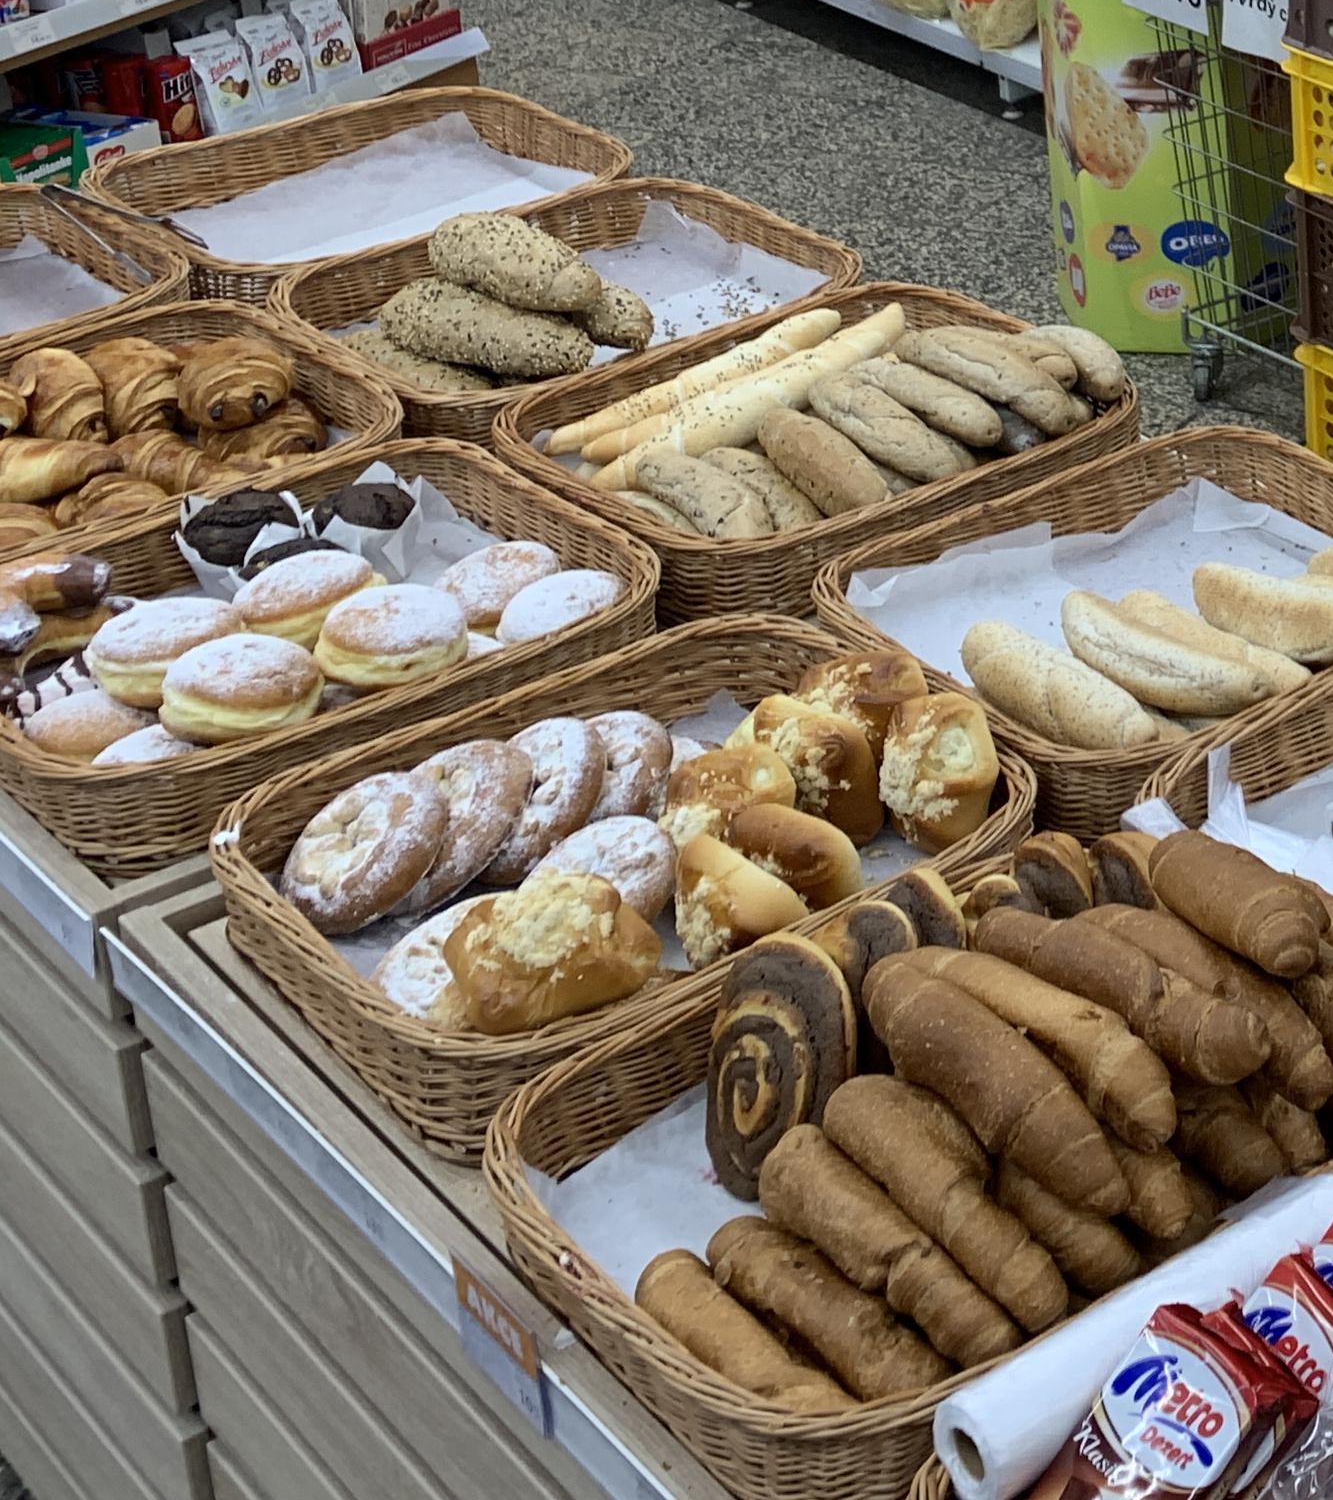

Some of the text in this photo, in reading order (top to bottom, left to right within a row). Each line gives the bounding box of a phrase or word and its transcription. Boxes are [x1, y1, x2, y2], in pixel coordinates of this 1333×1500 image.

[467, 1283, 524, 1360] AKCE
[1243, 1306, 1328, 1394] Metro
[1111, 1355, 1225, 1439] Metro
[1072, 1421, 1120, 1478] Klasi
[1139, 1425, 1195, 1471] Dezert
